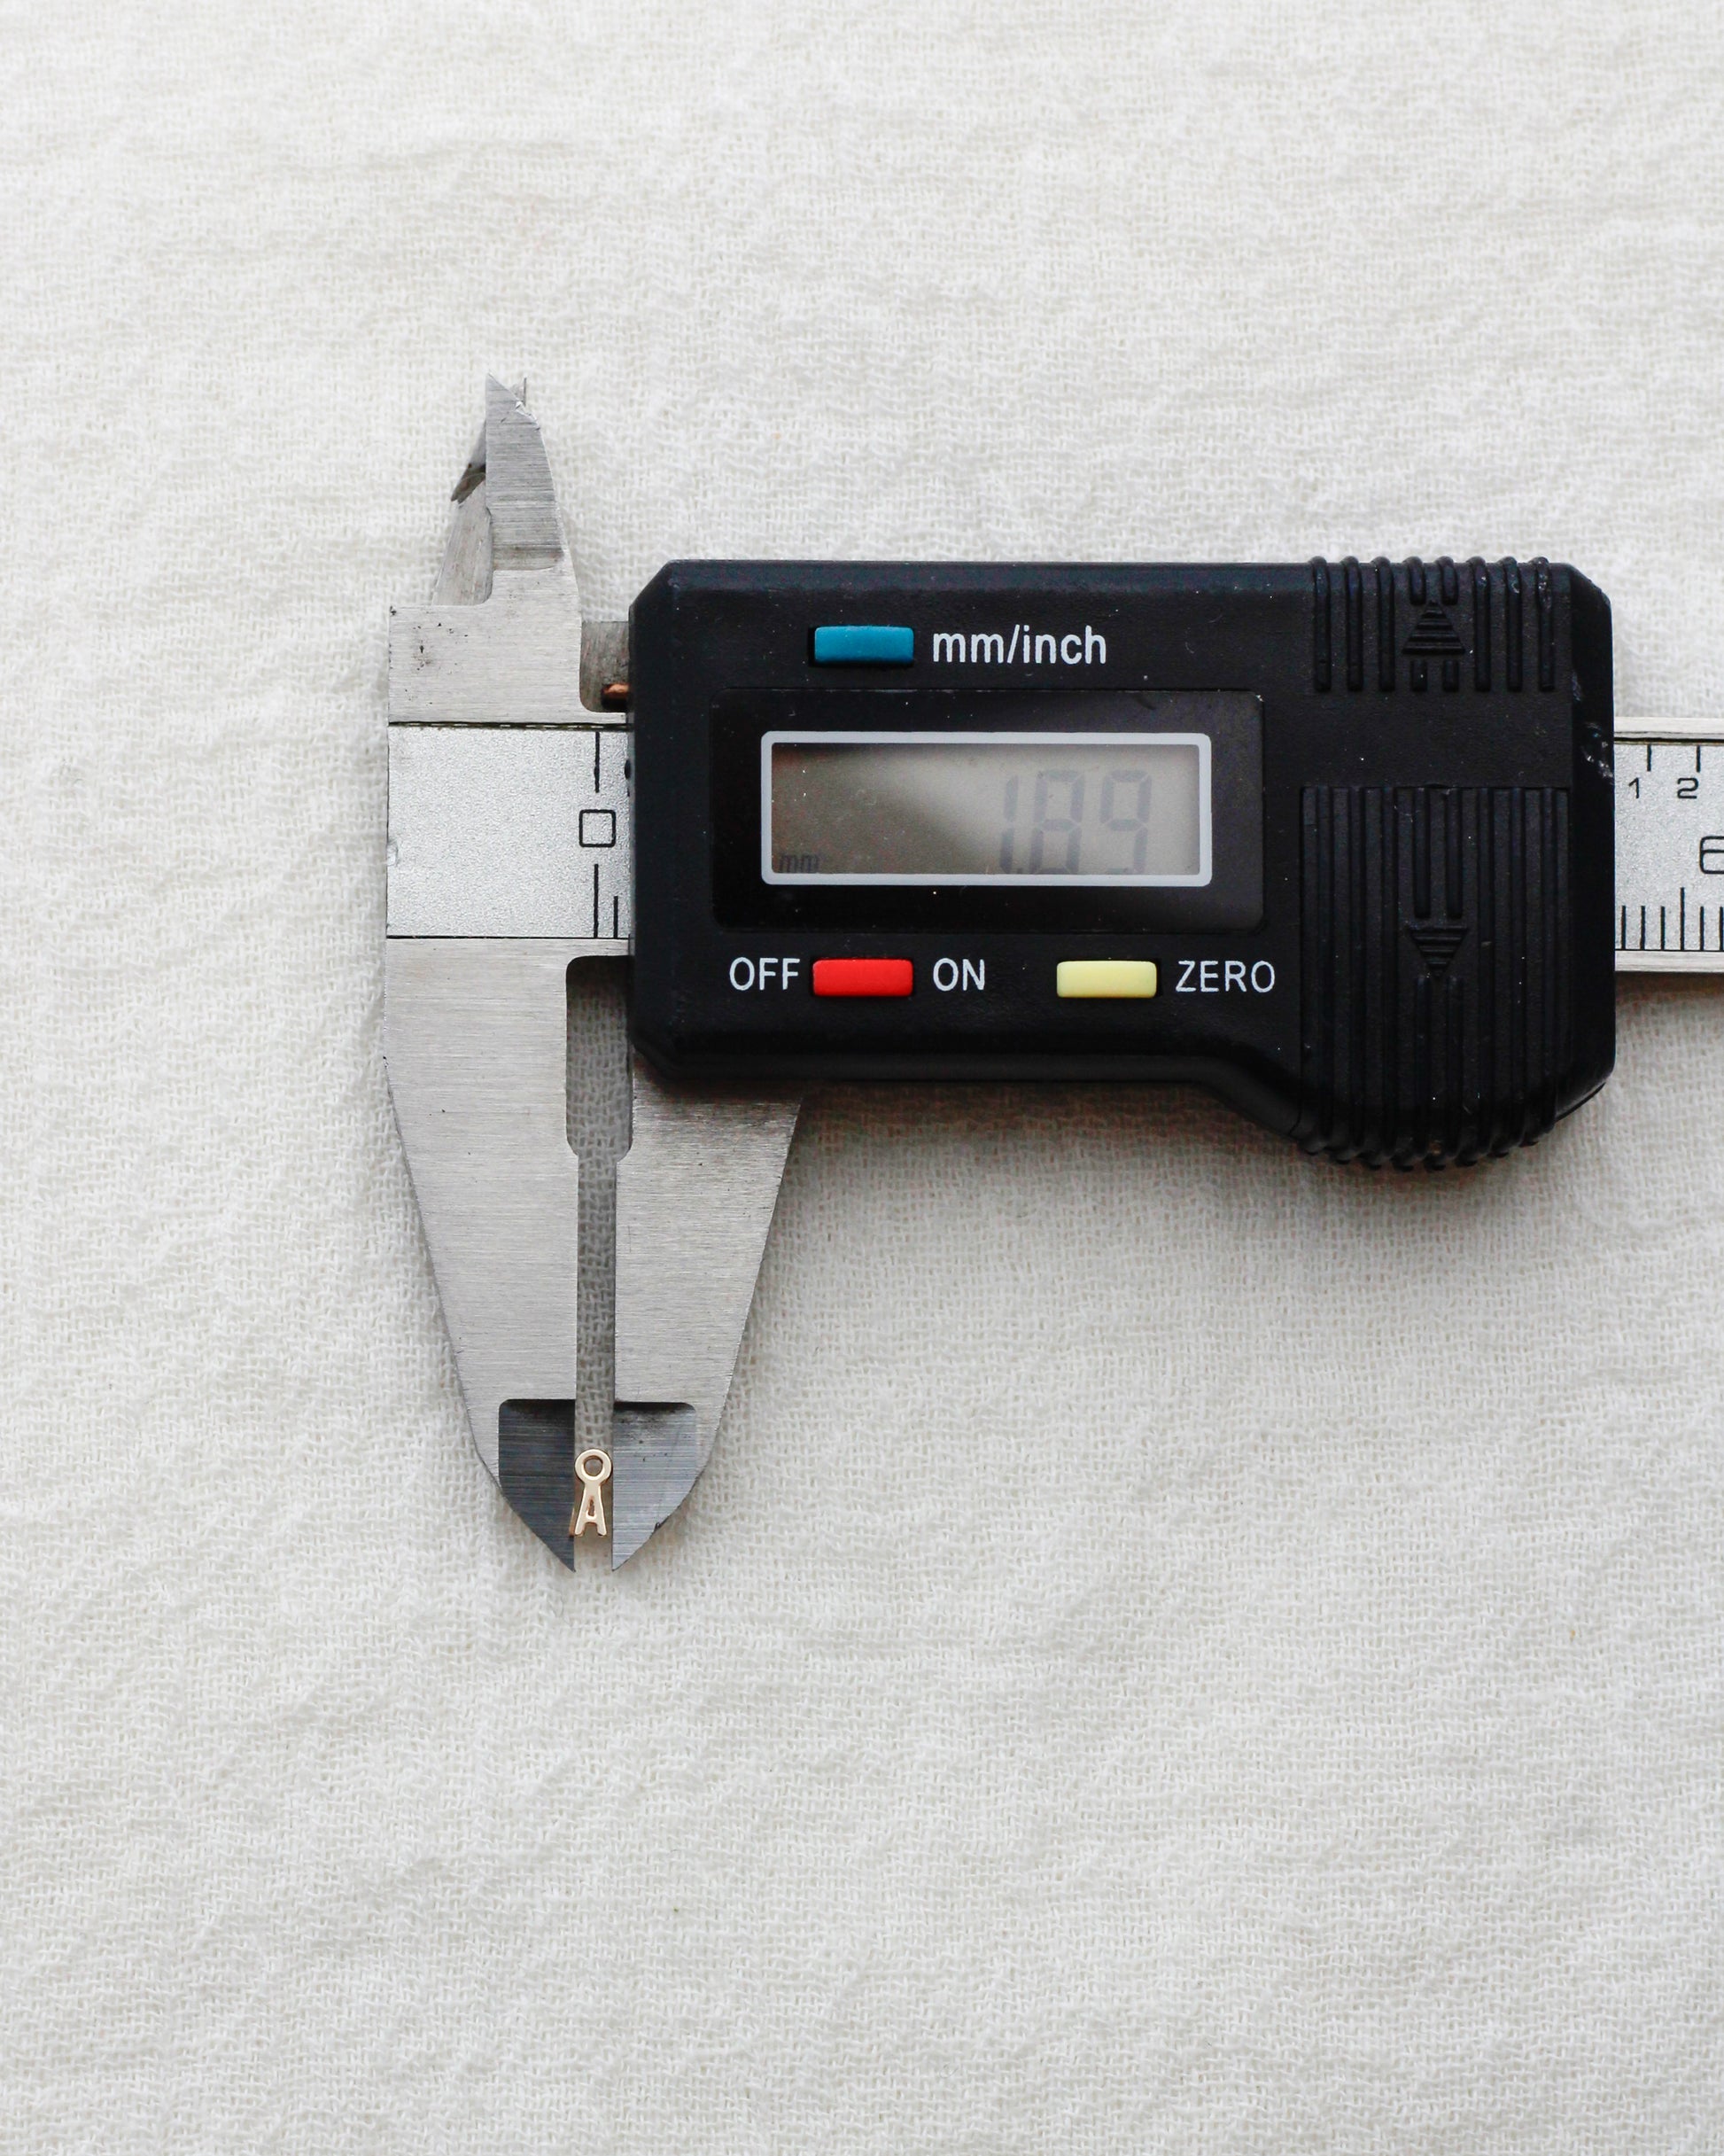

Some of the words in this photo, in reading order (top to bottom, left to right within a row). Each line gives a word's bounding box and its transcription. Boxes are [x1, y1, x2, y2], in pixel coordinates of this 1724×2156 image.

[933, 624, 1107, 665] mm/inch
[1628, 777, 1640, 799] 1
[1677, 777, 1699, 799] 2
[729, 957, 801, 992] OFF
[933, 958, 986, 992] ON
[1176, 960, 1276, 993] ZERO
